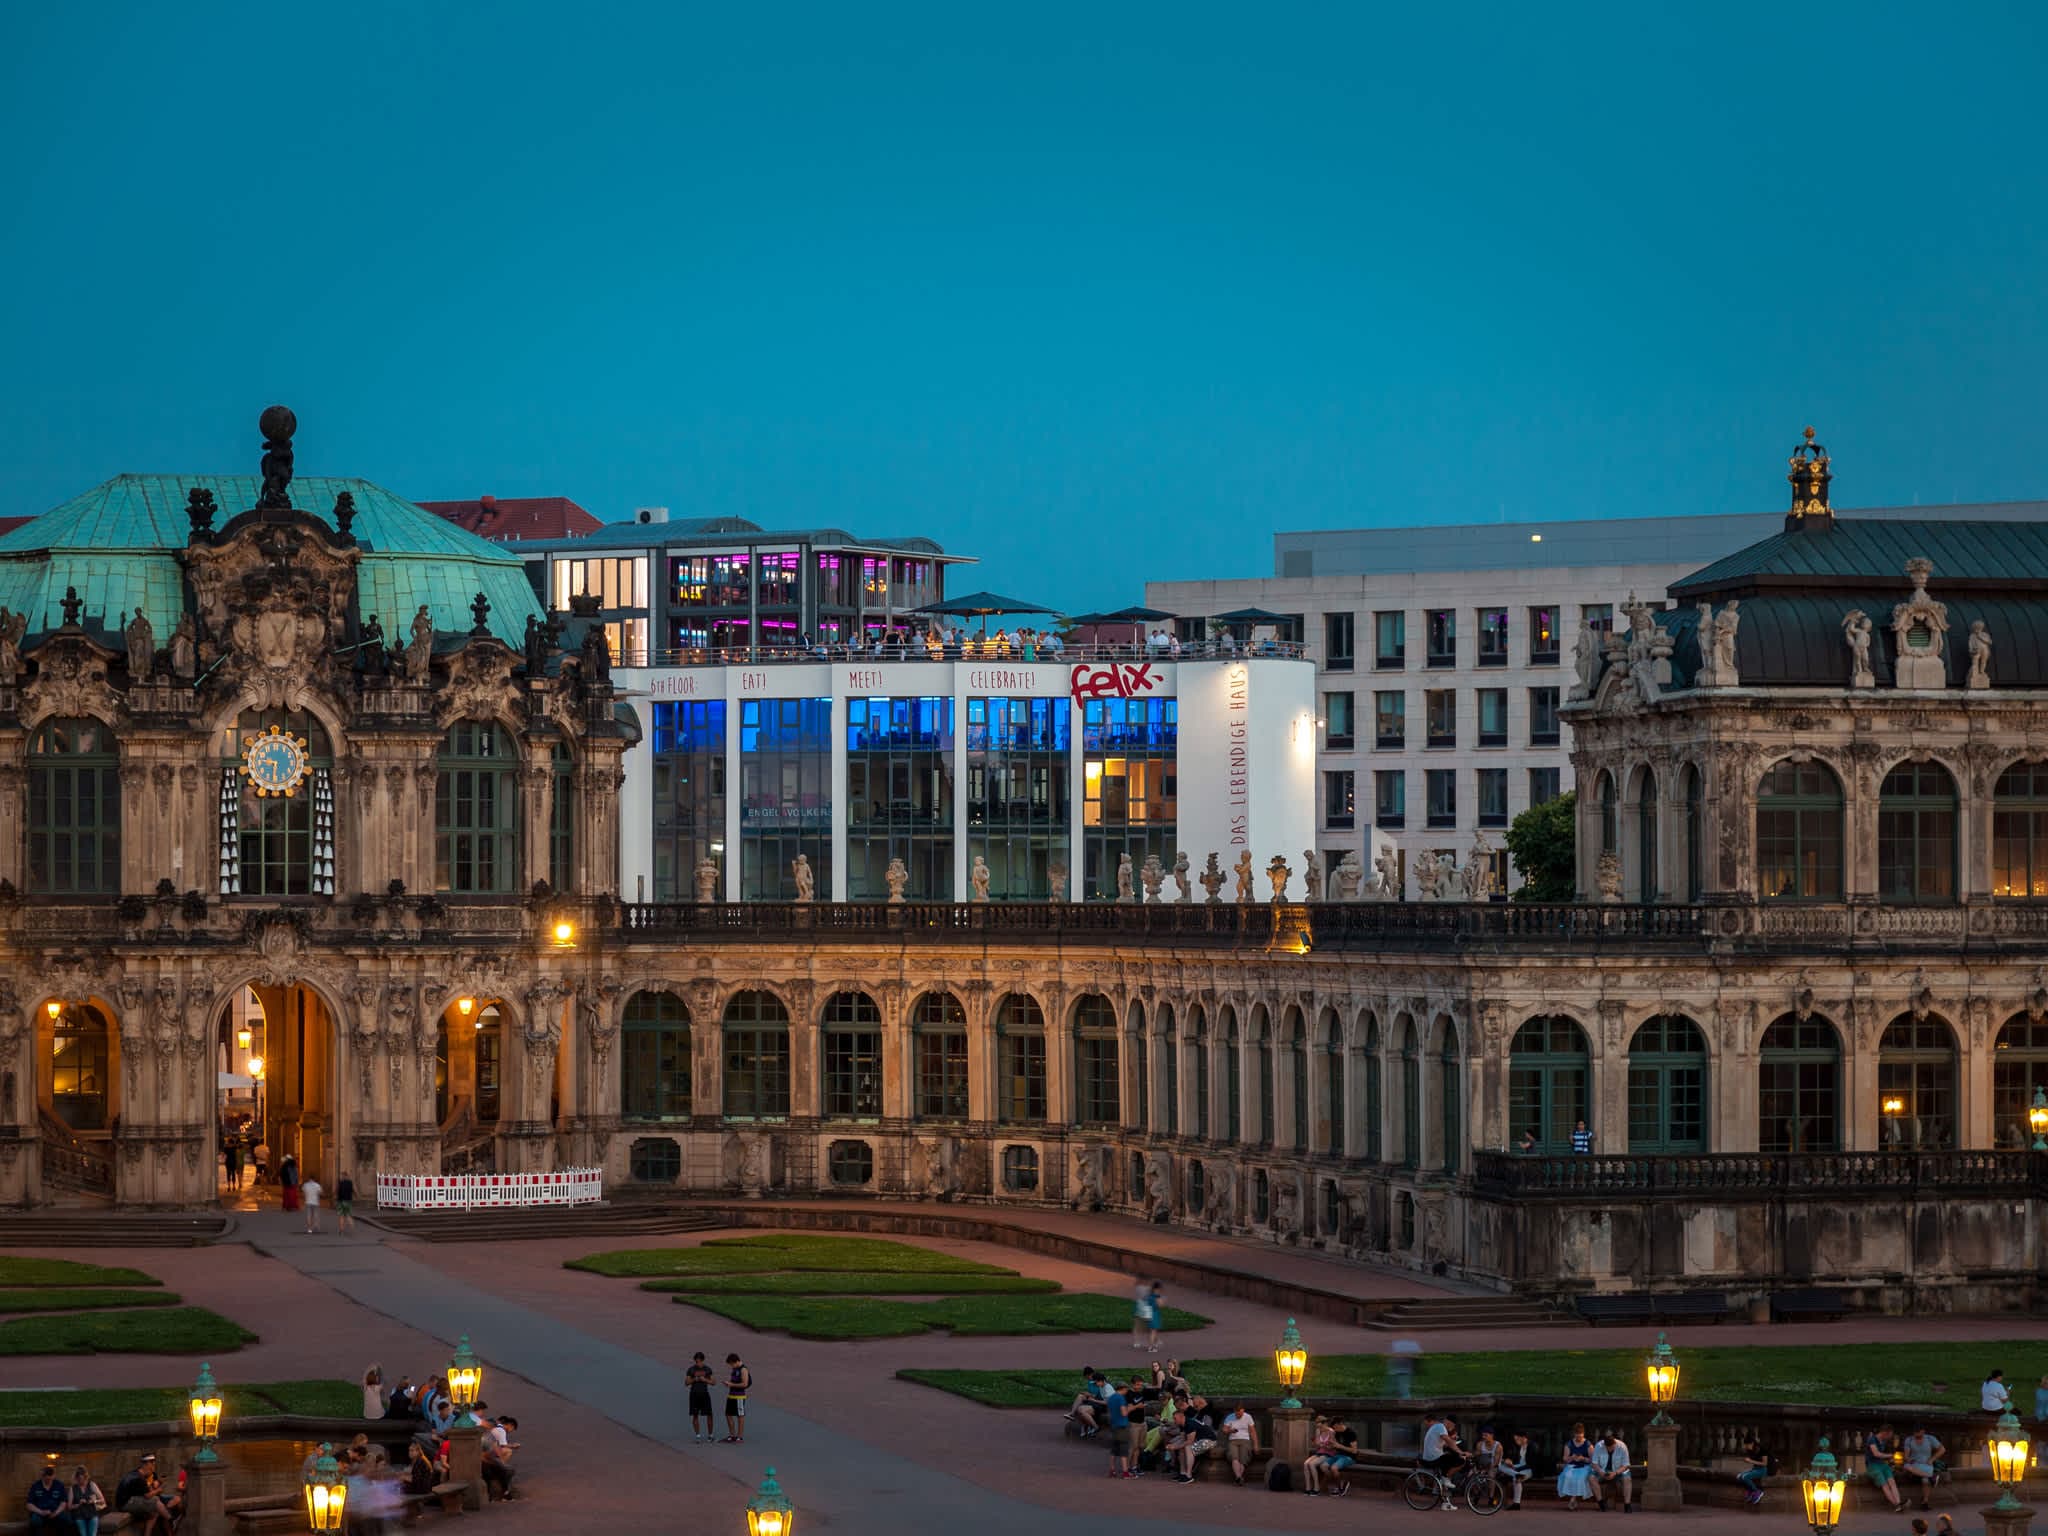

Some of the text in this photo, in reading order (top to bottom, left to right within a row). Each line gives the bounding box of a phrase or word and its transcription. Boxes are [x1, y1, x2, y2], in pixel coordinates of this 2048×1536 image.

[742, 672, 767, 690] EAT!
[849, 671, 883, 689] MEET!
[970, 671, 1035, 690] CELEBRATE!
[1230, 669, 1246, 845] DAS LEBENDIGE HAUS
[748, 808, 779, 817] ENGEL
